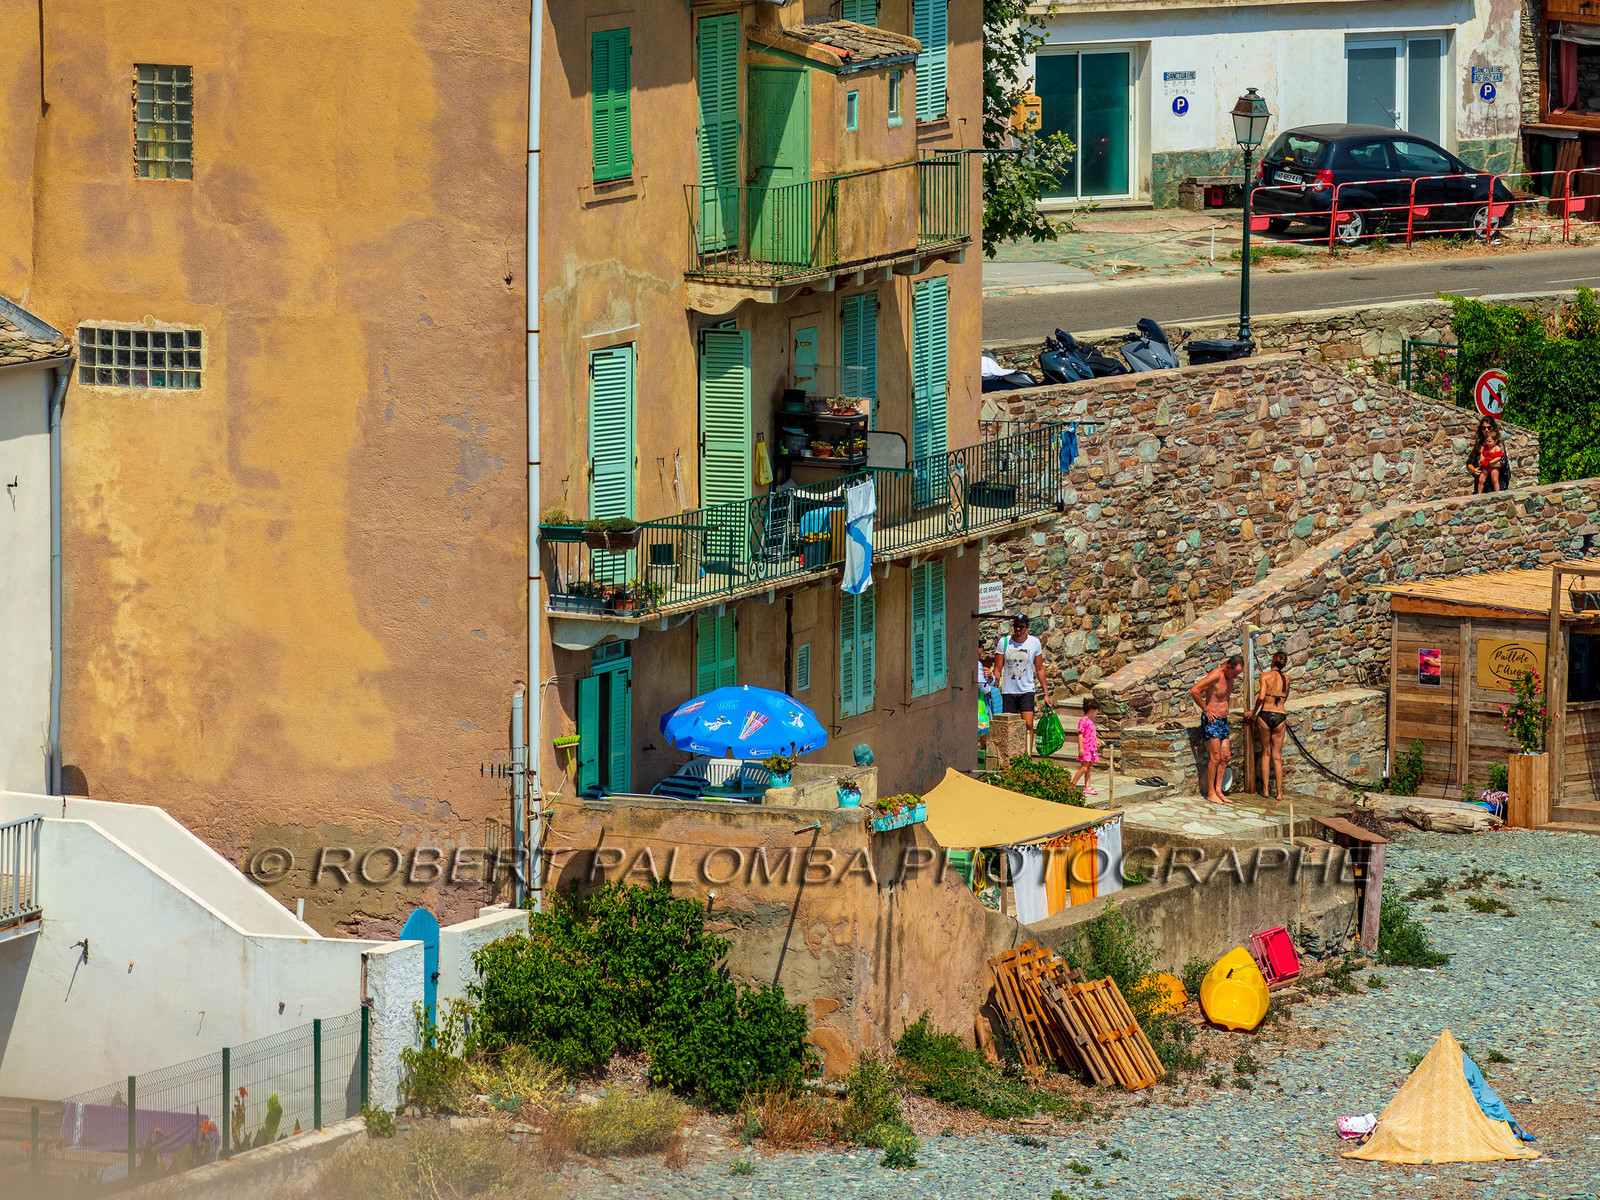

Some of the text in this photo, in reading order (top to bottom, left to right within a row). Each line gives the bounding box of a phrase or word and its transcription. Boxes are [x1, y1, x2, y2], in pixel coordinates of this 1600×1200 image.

[1167, 71, 1196, 80] SANCTUAIRE
[1484, 85, 1492, 96] P
[1177, 99, 1185, 110] P
[1495, 651, 1529, 663] Paillote
